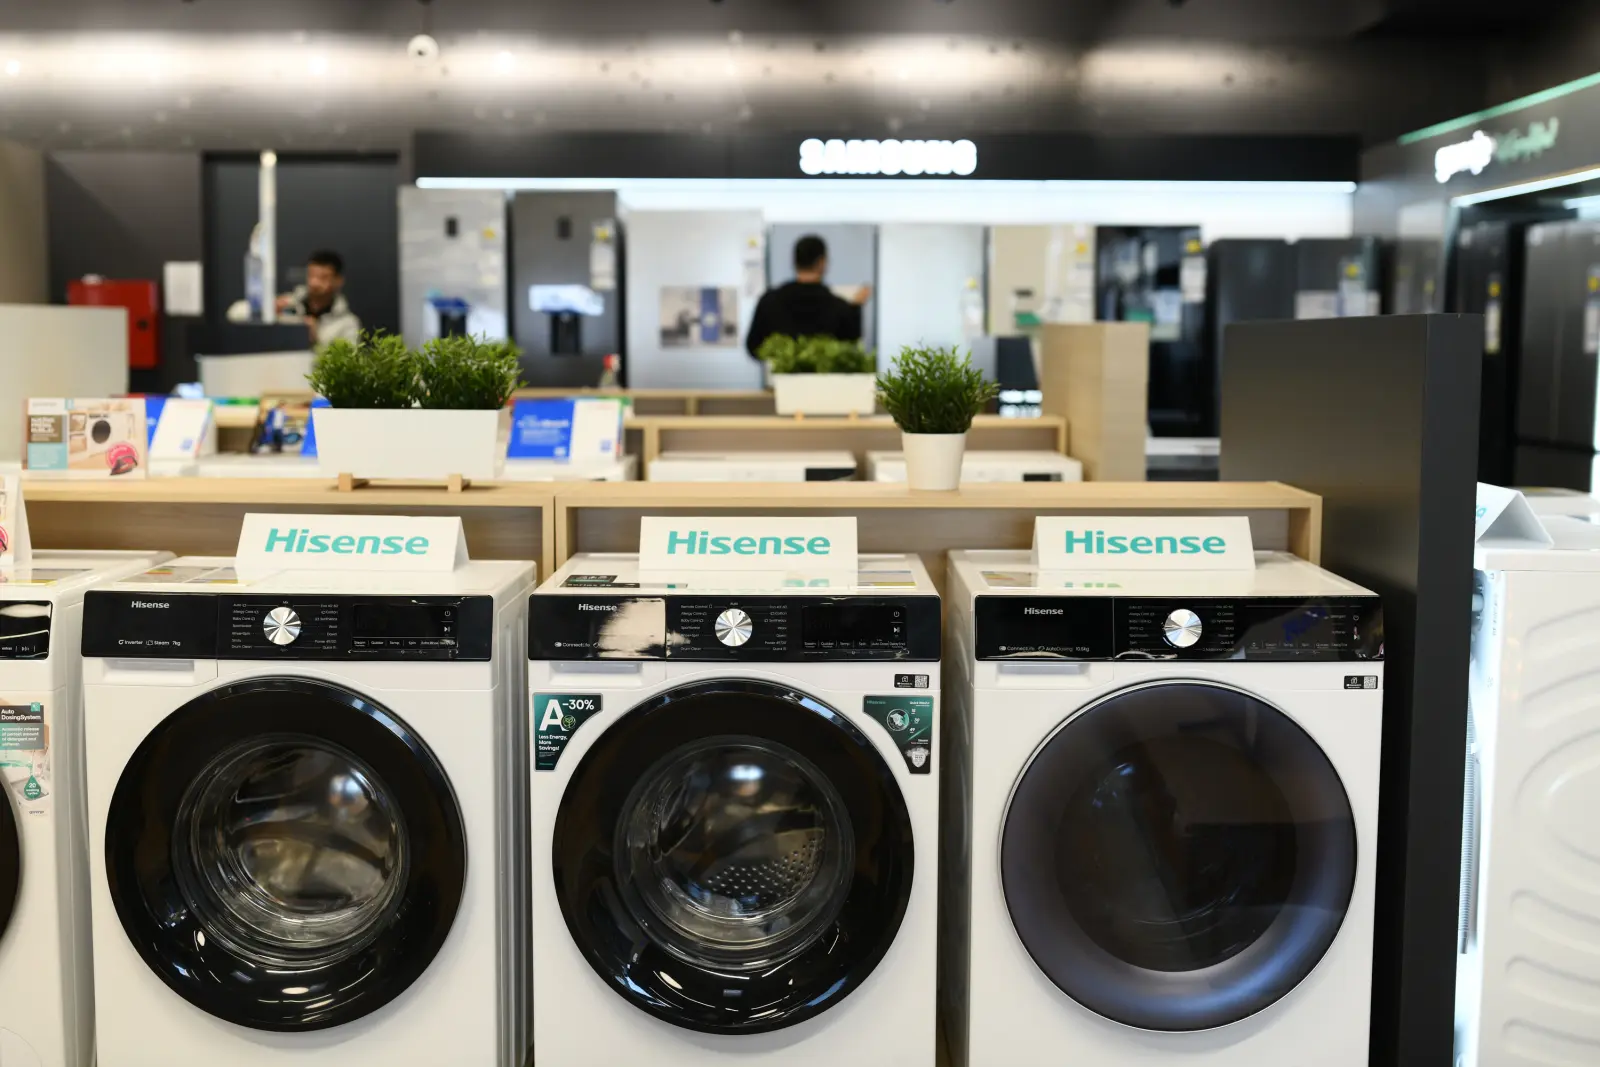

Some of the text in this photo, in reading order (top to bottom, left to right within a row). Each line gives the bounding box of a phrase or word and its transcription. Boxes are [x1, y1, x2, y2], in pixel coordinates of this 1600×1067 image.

[800, 138, 976, 175] SAMSUNG
[265, 528, 429, 554] Hisense
[667, 531, 830, 555] Hisense
[1065, 530, 1226, 554] Hisense
[563, 700, 594, 710] -30%
